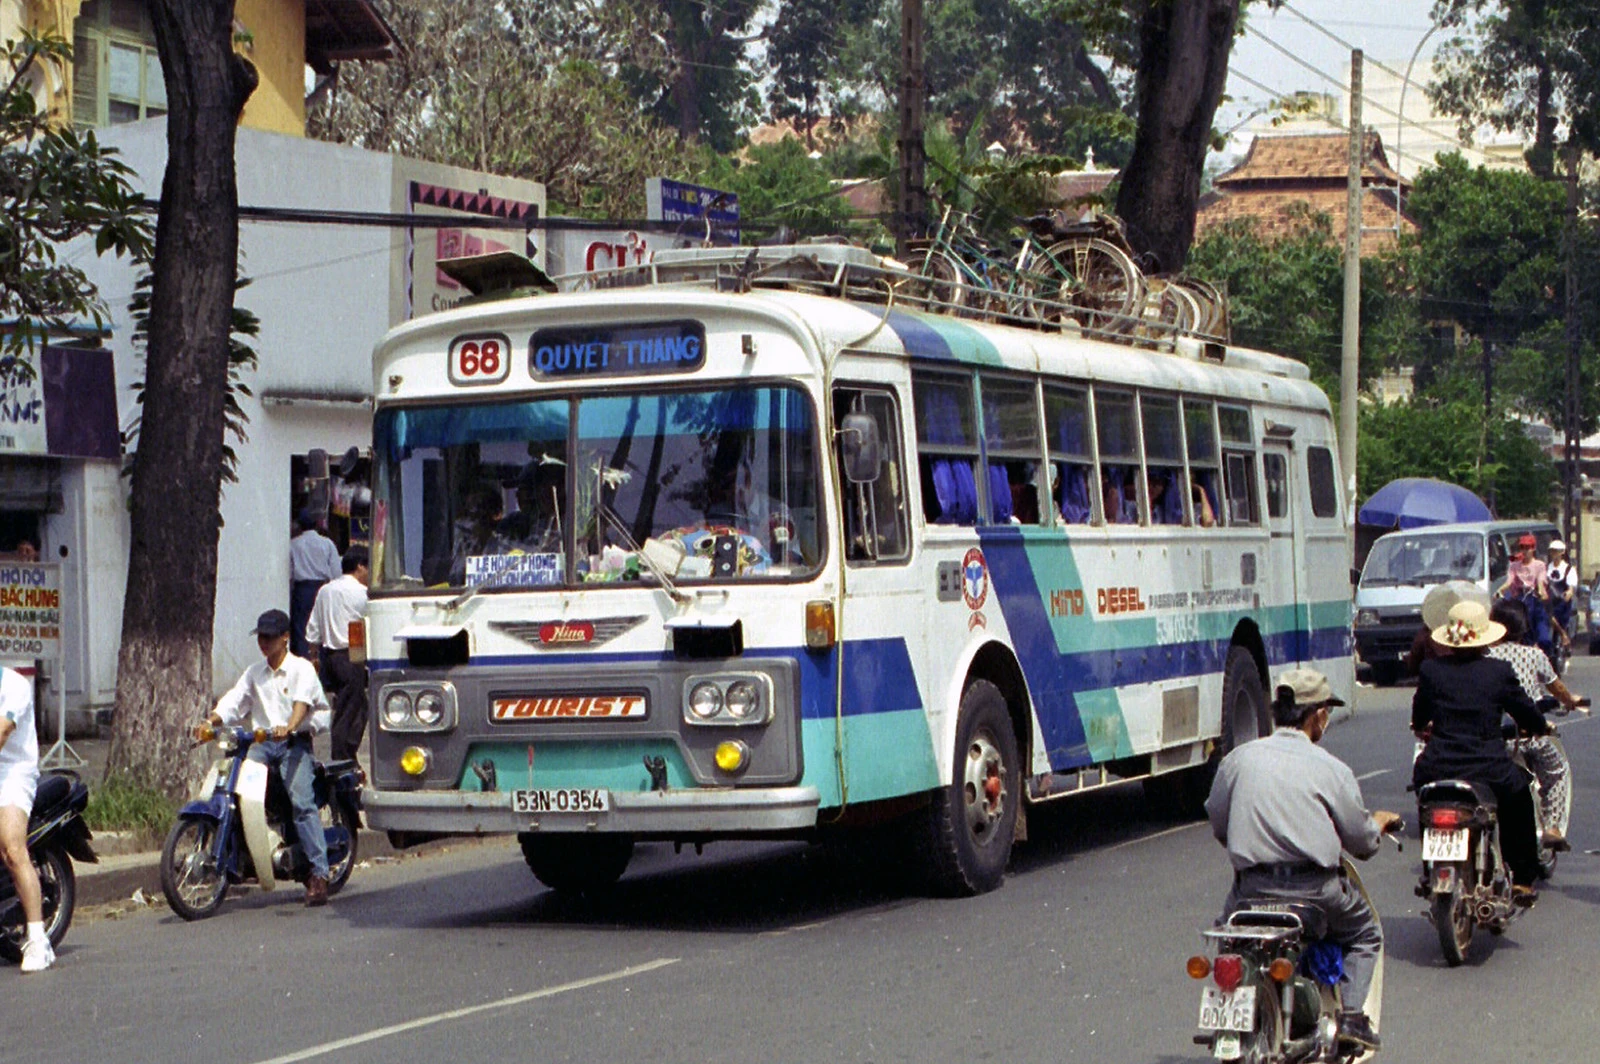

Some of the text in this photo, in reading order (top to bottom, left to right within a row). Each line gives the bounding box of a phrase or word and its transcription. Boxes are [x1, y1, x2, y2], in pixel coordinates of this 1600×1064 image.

[459, 340, 500, 376] 68
[1097, 587, 1146, 614] DIESEL
[495, 695, 643, 718] TOURIST
